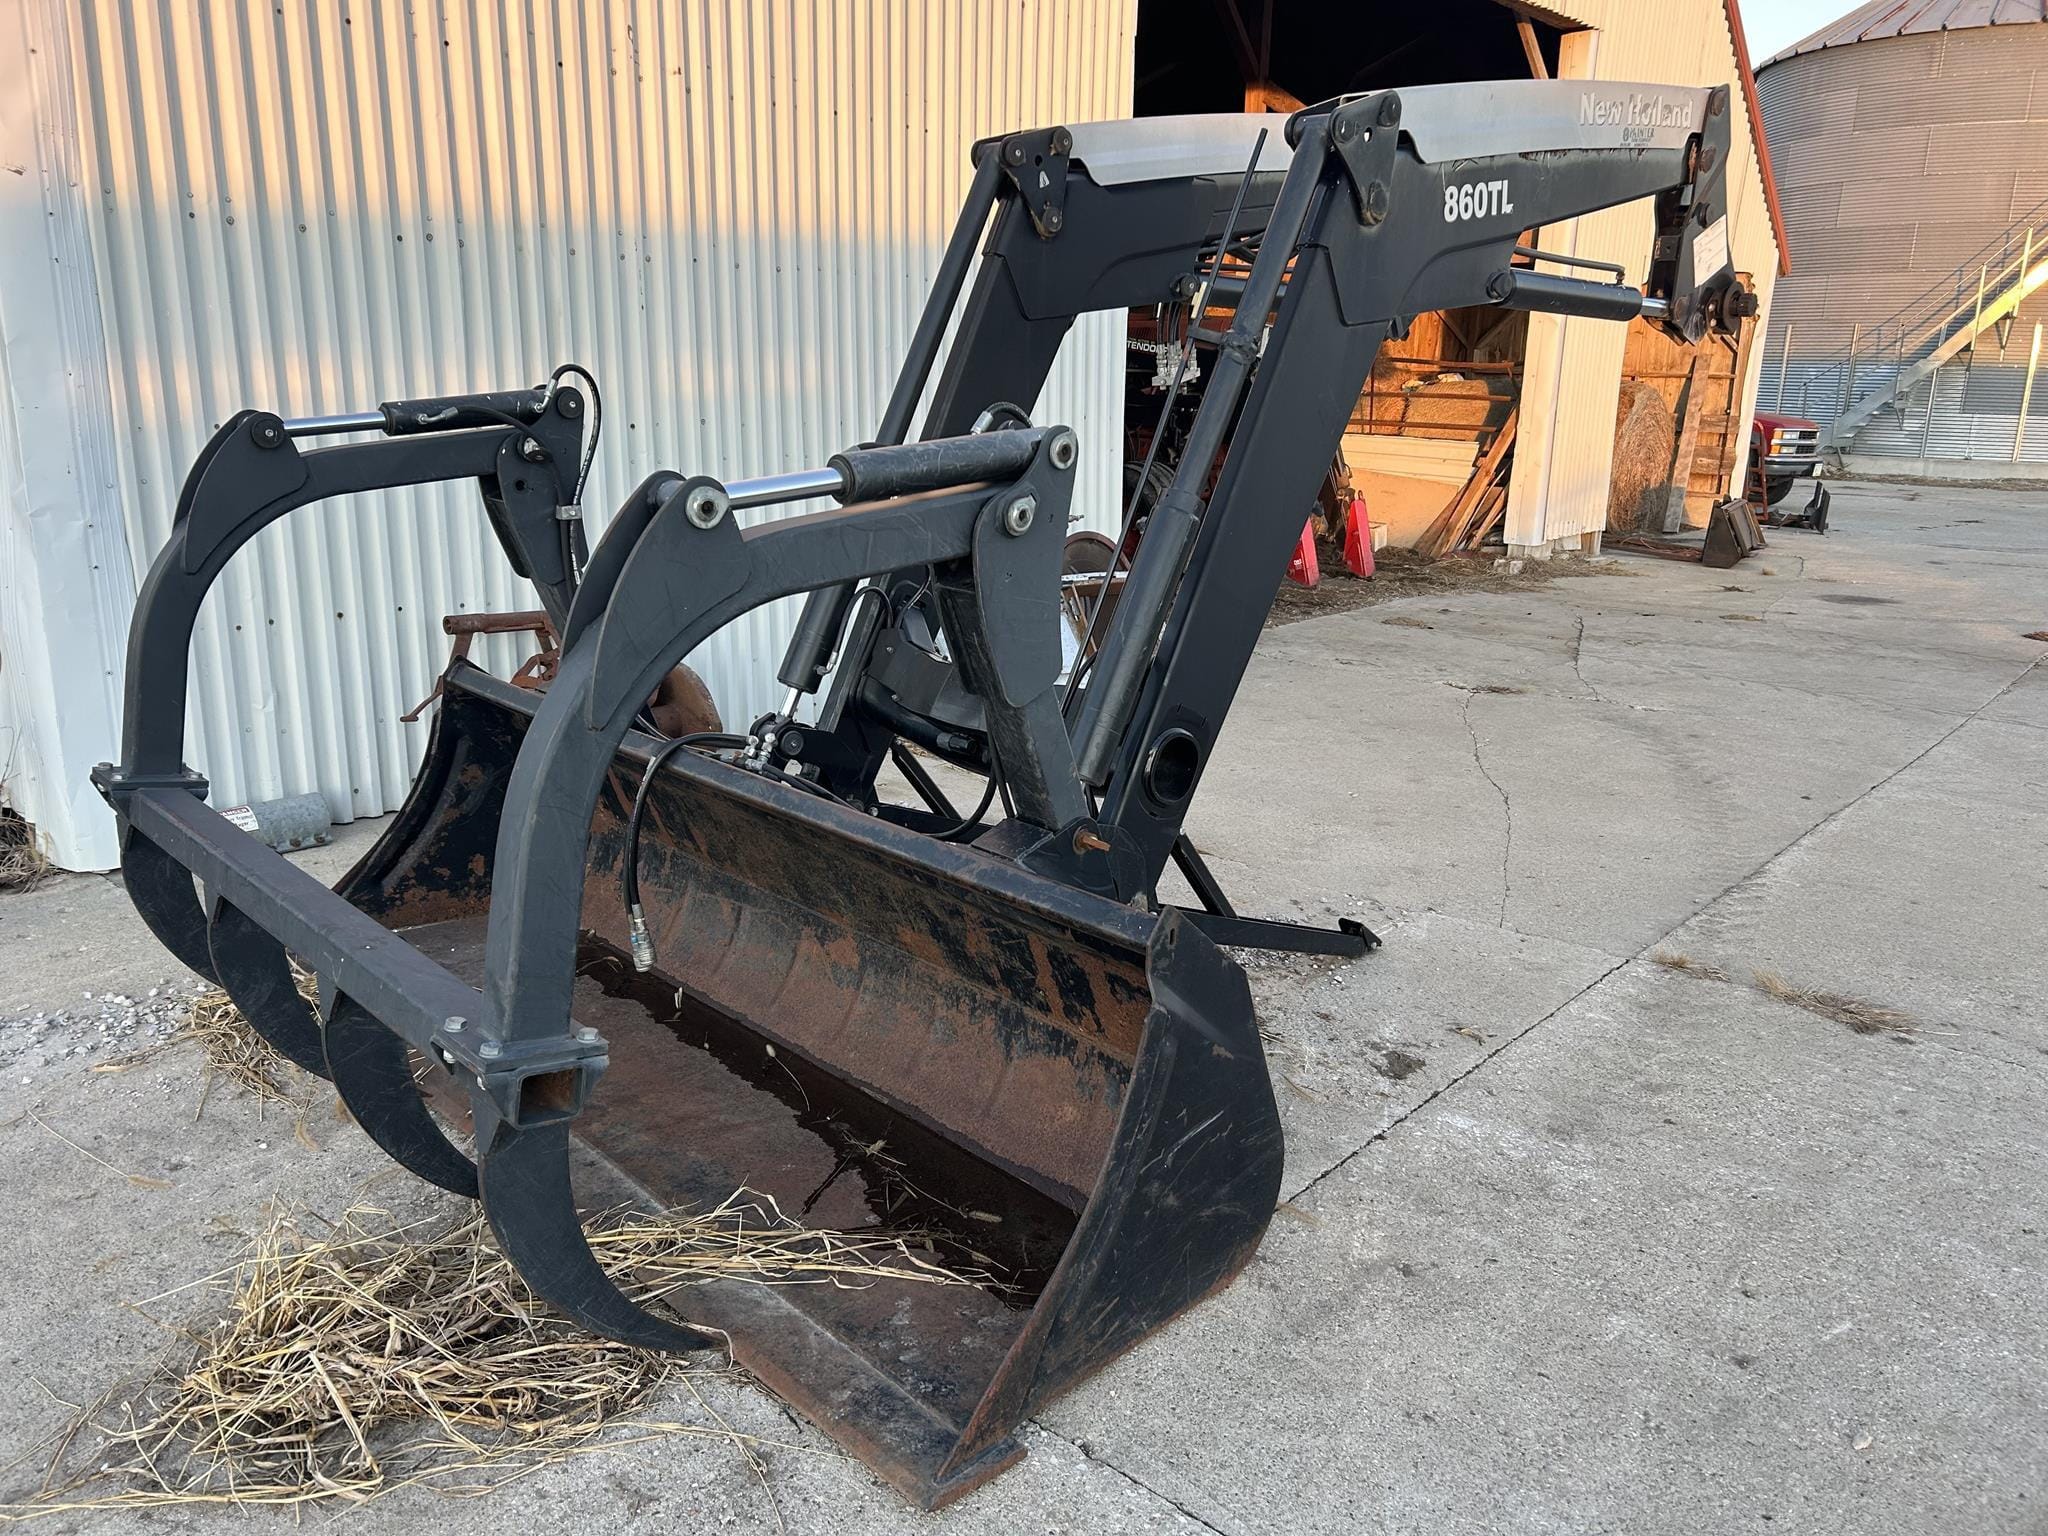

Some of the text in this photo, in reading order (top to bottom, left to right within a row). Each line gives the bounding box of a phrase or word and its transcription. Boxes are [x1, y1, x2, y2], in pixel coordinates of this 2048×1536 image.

[1579, 92, 1693, 128] New Holland
[1444, 179, 1514, 223] 860TL
[219, 808, 248, 817] ANGER
